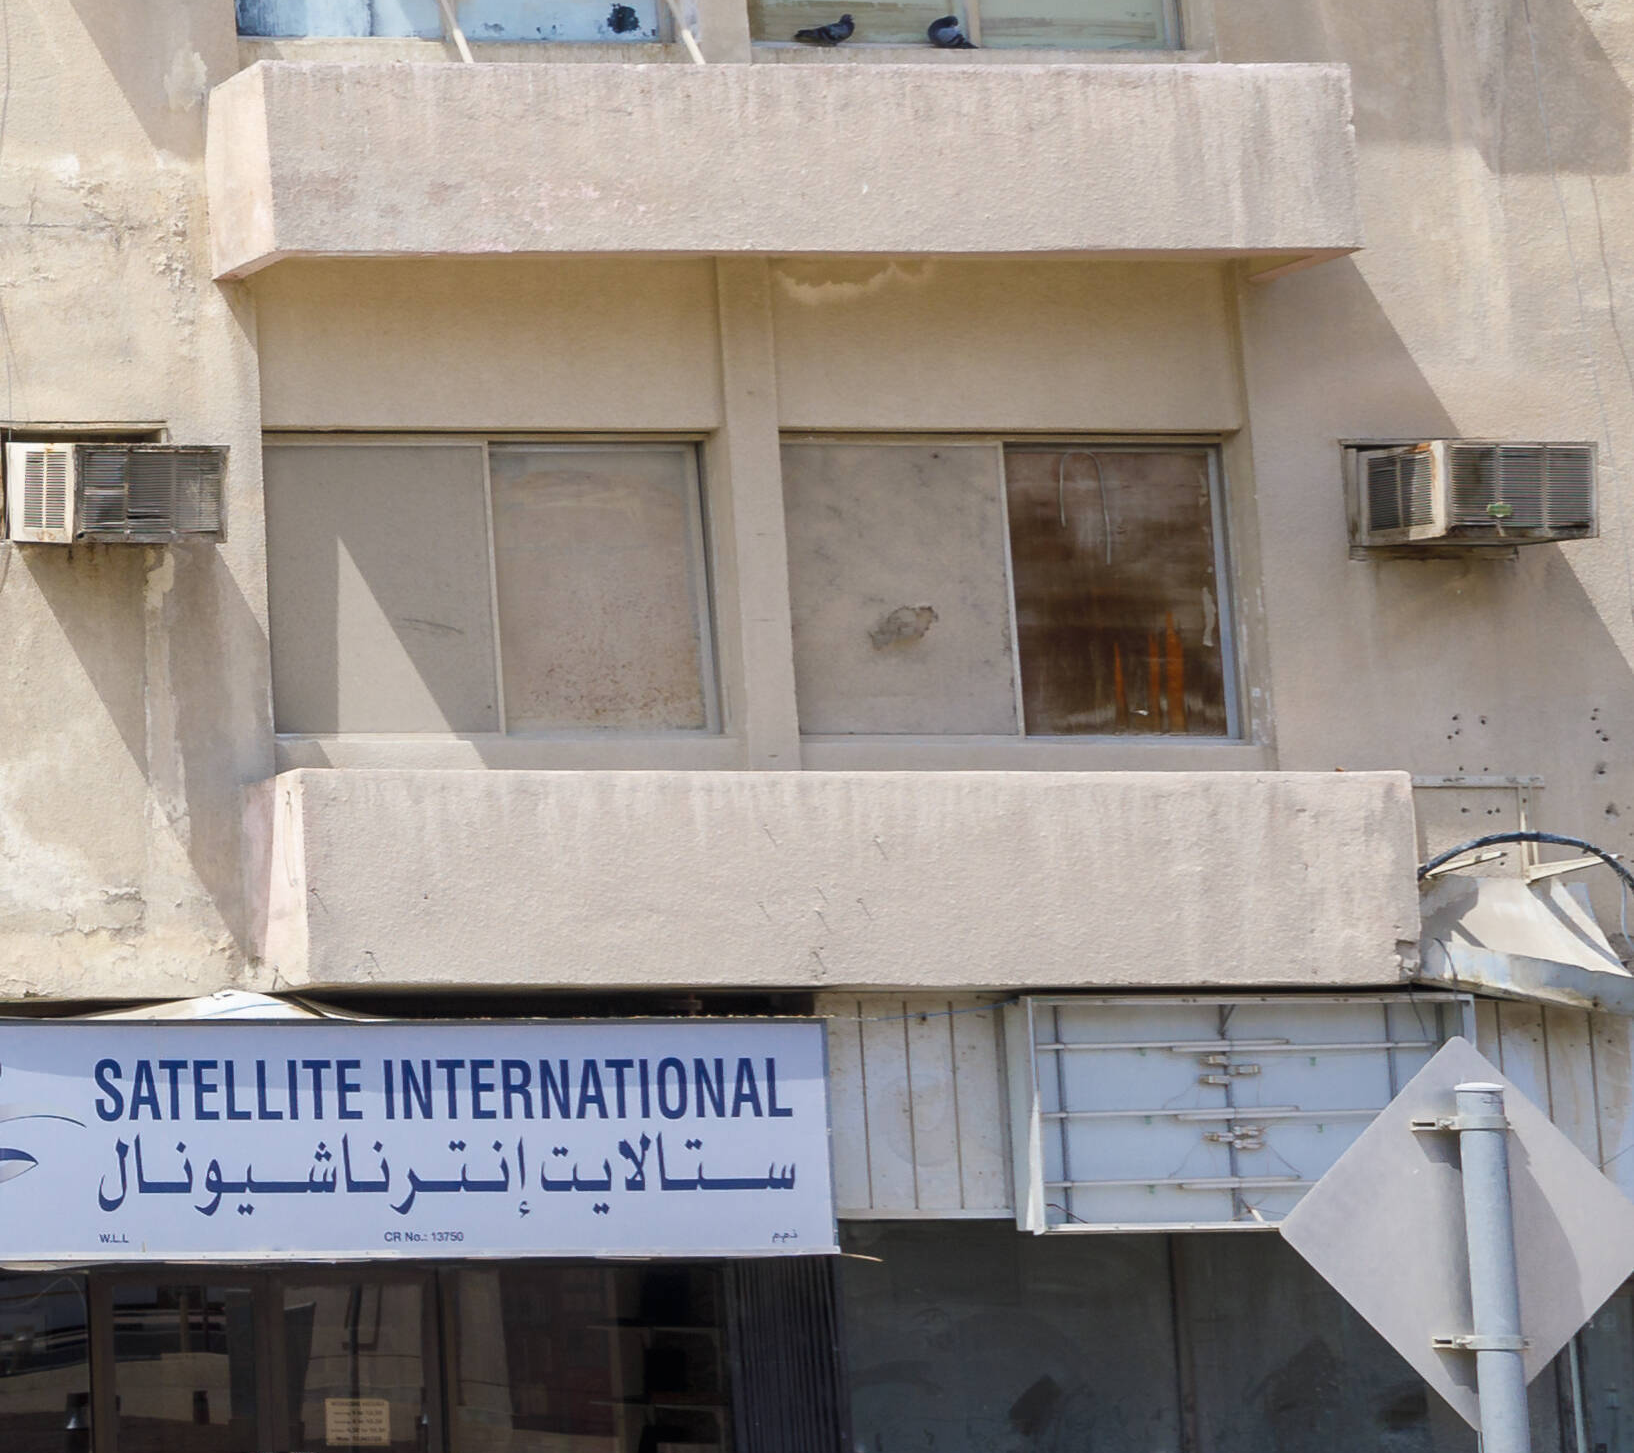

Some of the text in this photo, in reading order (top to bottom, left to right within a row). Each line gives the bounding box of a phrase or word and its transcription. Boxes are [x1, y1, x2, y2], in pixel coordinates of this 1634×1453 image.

[94, 1056, 793, 1122] SATELLITE INTERNATIONAL
[98, 1130, 797, 1219] ستالايت إنترناشيونال
[383, 1231, 402, 1243] CR
[431, 1231, 464, 1243] 13750
